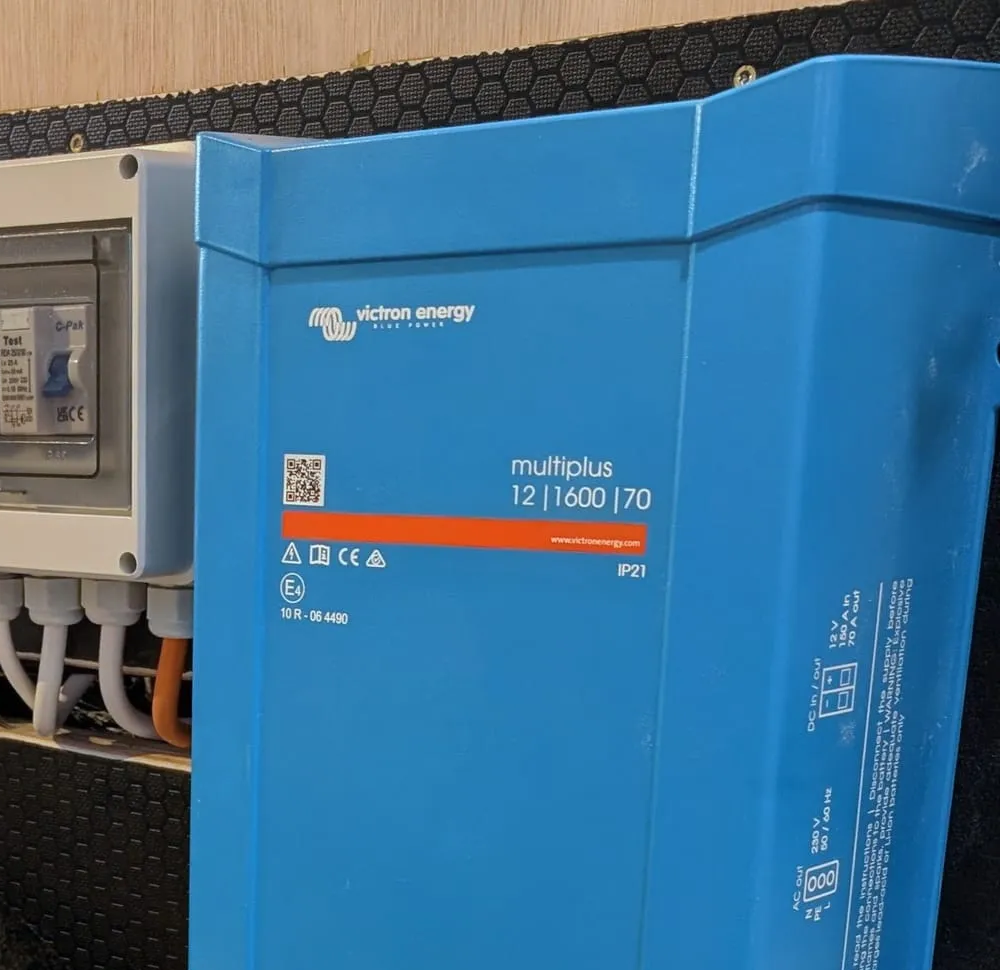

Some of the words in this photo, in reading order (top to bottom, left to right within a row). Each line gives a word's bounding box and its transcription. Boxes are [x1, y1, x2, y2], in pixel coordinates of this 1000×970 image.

[357, 304, 411, 321] victron
[416, 304, 475, 322] energy
[56, 319, 85, 332] C-Pak
[3, 335, 23, 346] Test
[512, 456, 613, 480] multiplus
[512, 485, 535, 506] 12
[551, 535, 641, 549] www.victronenergy.com
[617, 564, 646, 578] IP21
[843, 594, 850, 607] in
[852, 589, 861, 613] out
[887, 581, 898, 629] before
[281, 608, 291, 619] 10
[294, 608, 302, 620] R
[309, 610, 322, 622] 06
[324, 611, 348, 624] 4490
[841, 610, 849, 621] A
[850, 616, 857, 627] A
[892, 580, 905, 644] Explosive
[831, 620, 838, 631] V
[839, 625, 848, 647] 150
[829, 635, 837, 649] 12
[848, 631, 856, 648] 70
[812, 658, 821, 680] out
[881, 637, 892, 683] supply
[810, 694, 818, 706] in
[877, 690, 887, 713] the
[807, 710, 817, 732] DC
[870, 896, 879, 918] and
[879, 787, 890, 839] provide
[895, 630, 908, 704] ventilation
[902, 578, 913, 624] during
[869, 721, 883, 801] Disconnect
[824, 787, 832, 803] Hz
[883, 850, 890, 863] or
[894, 714, 905, 742] only
[823, 807, 831, 822] 60
[874, 794, 883, 817] the
[812, 817, 821, 828] V
[872, 820, 880, 835] to
[859, 823, 873, 899] instructions
[795, 865, 803, 887] out
[864, 838, 879, 921] connections
[792, 890, 801, 911] AC
[814, 905, 822, 921] PE
[856, 905, 865, 928] the
[860, 925, 869, 948] the
[852, 934, 861, 966] read
